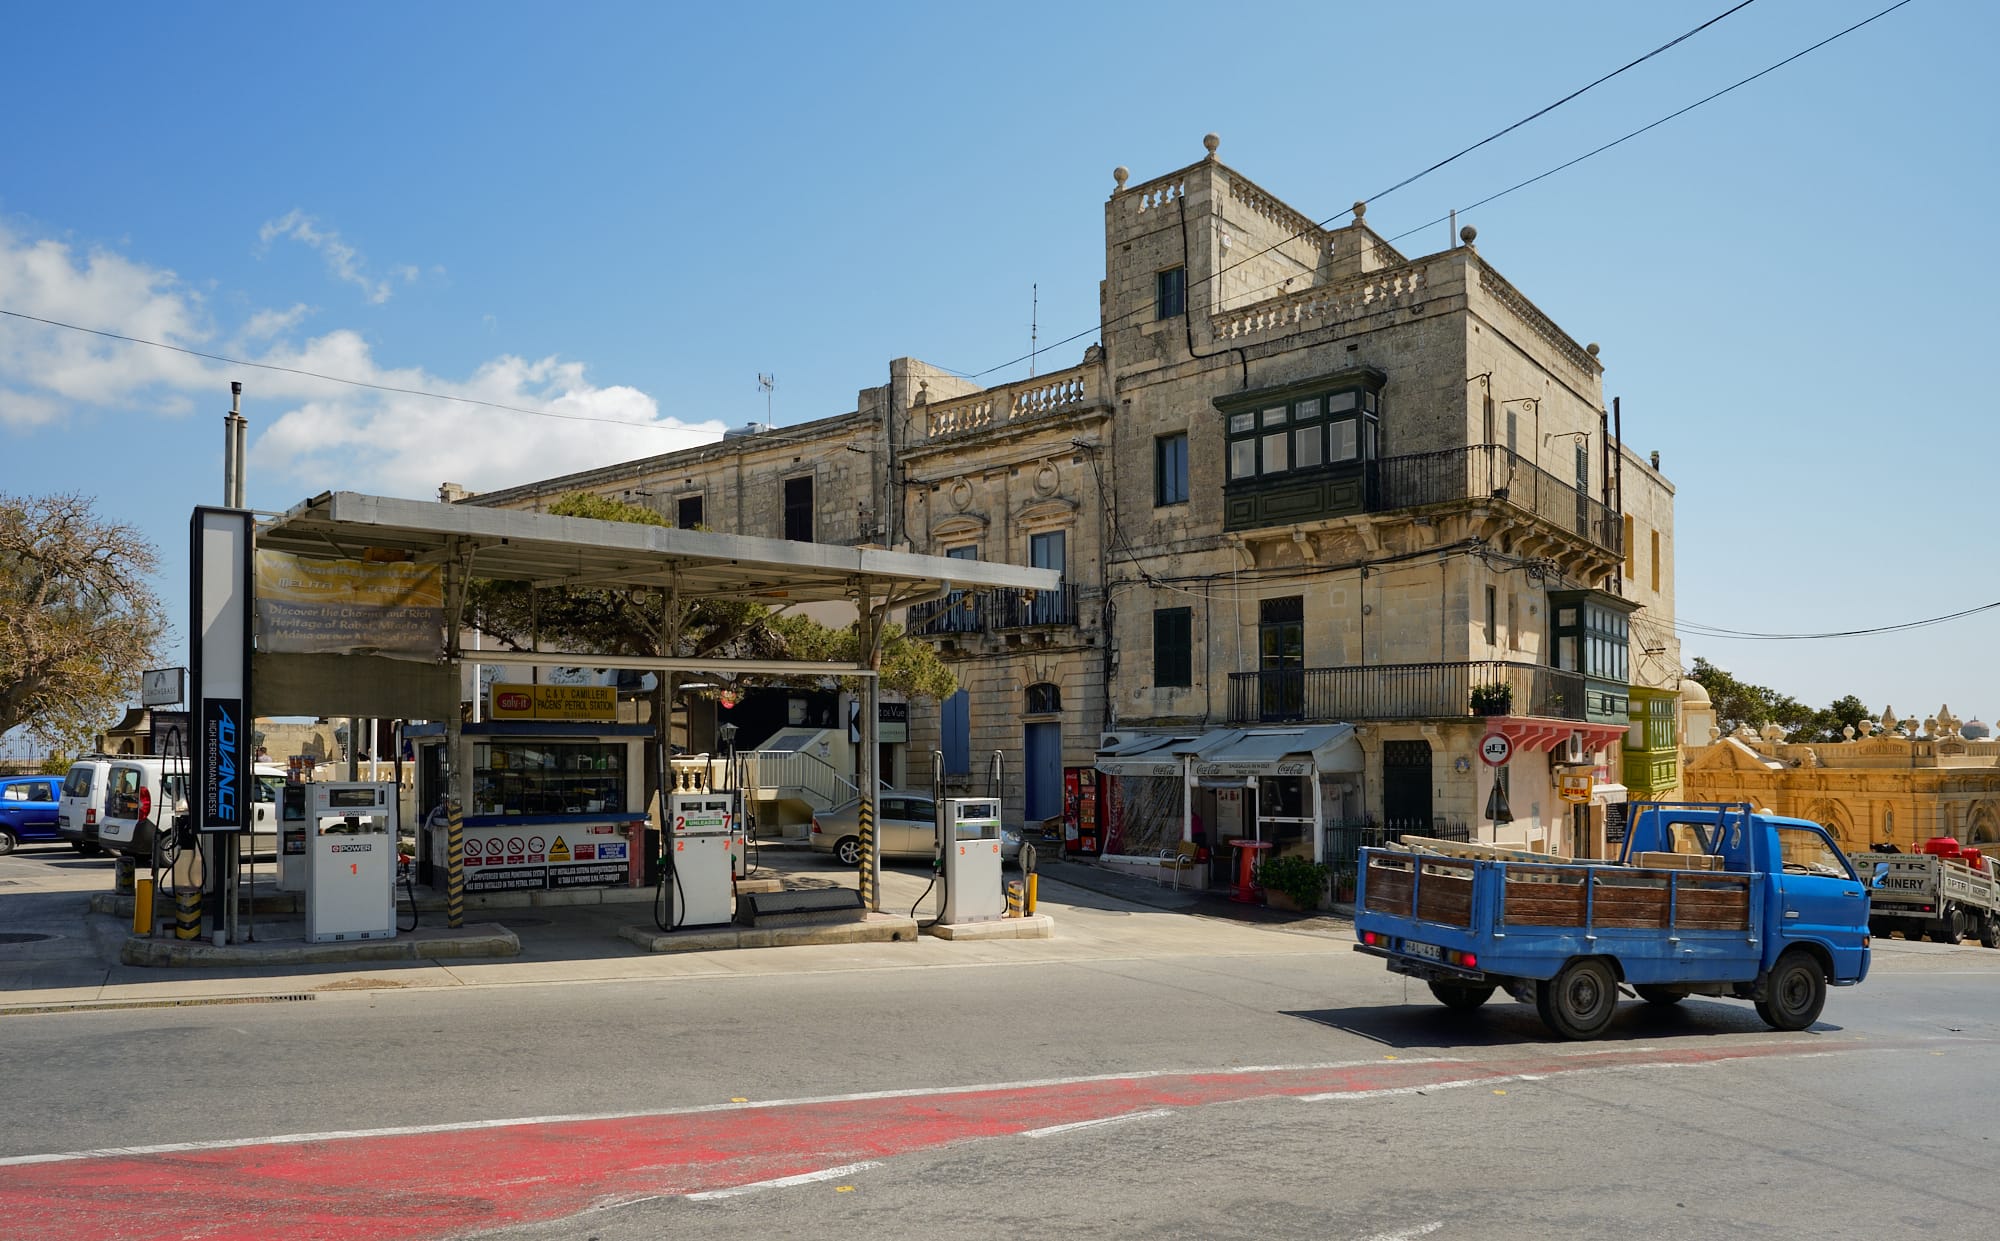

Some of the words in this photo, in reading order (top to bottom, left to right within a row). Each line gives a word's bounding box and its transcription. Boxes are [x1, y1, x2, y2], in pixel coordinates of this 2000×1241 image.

[268, 605, 319, 616] Discover
[386, 609, 407, 618] and
[409, 609, 432, 619] Rich
[270, 617, 322, 629] Heritage
[325, 618, 337, 629] of
[276, 629, 313, 640] Mdina
[570, 688, 609, 700] CAMILLERI
[564, 699, 588, 711] PETROL
[589, 700, 615, 712] STATION
[208, 719, 217, 737] HIGH
[208, 738, 217, 791] PERFORMANCE
[218, 704, 236, 822] ADVANCE
[1277, 763, 1305, 775] Coca-Cola
[208, 792, 217, 817] DIESEL
[675, 815, 685, 830] 2
[722, 814, 731, 829] 7
[676, 841, 685, 852] 2
[723, 839, 731, 851] 7
[959, 846, 966, 856] 3
[992, 844, 999, 854] 8
[350, 863, 358, 875] 1
[1873, 862, 1927, 871] TR
